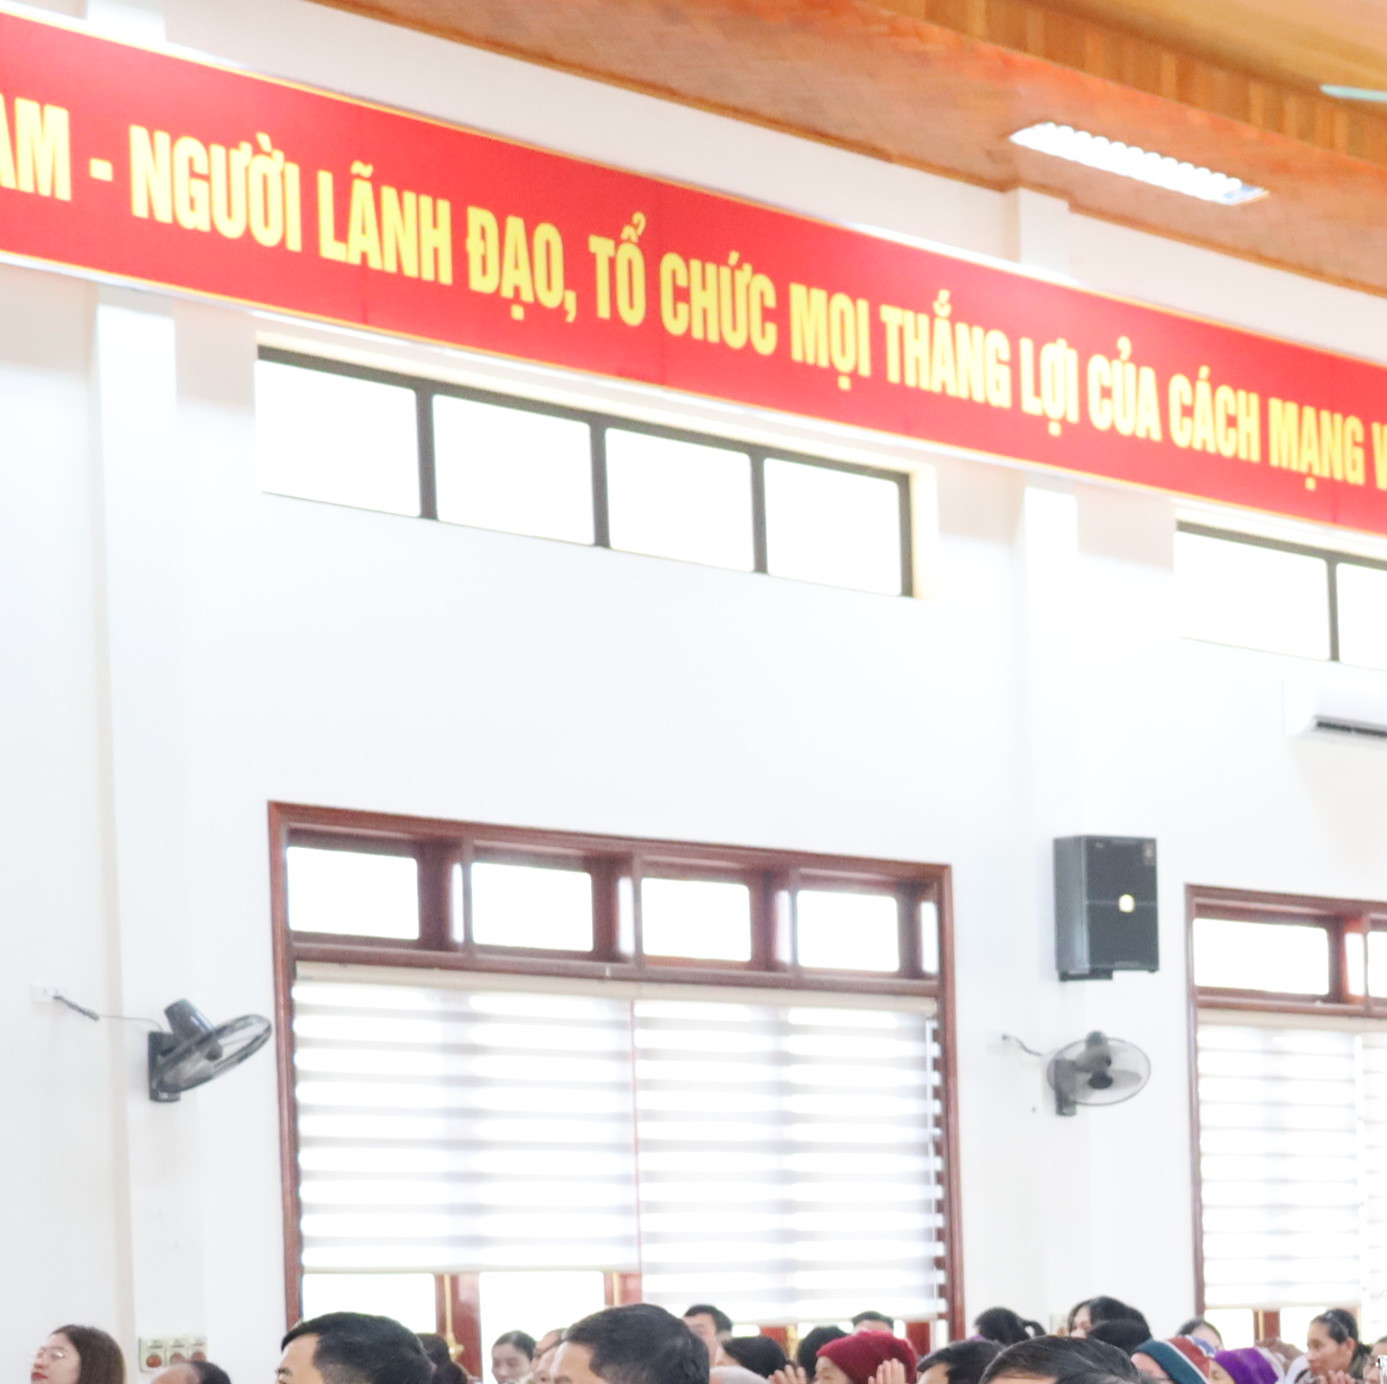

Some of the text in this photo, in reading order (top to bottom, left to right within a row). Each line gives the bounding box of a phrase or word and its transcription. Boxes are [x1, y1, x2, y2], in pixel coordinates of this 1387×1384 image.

[128, 124, 303, 253] NGƯỜI
[317, 160, 453, 286] LÃNH
[466, 205, 577, 323] ĐẠO,
[589, 211, 647, 327] TỔ
[660, 251, 778, 356] CHỨC
[790, 283, 872, 391] MỌI
[880, 288, 1013, 410] THẮNG
[1018, 336, 1082, 438] LỢI
[1086, 335, 1164, 443] CỦA
[1168, 364, 1262, 464] CÁCH
[1268, 397, 1366, 492] MẠNG
